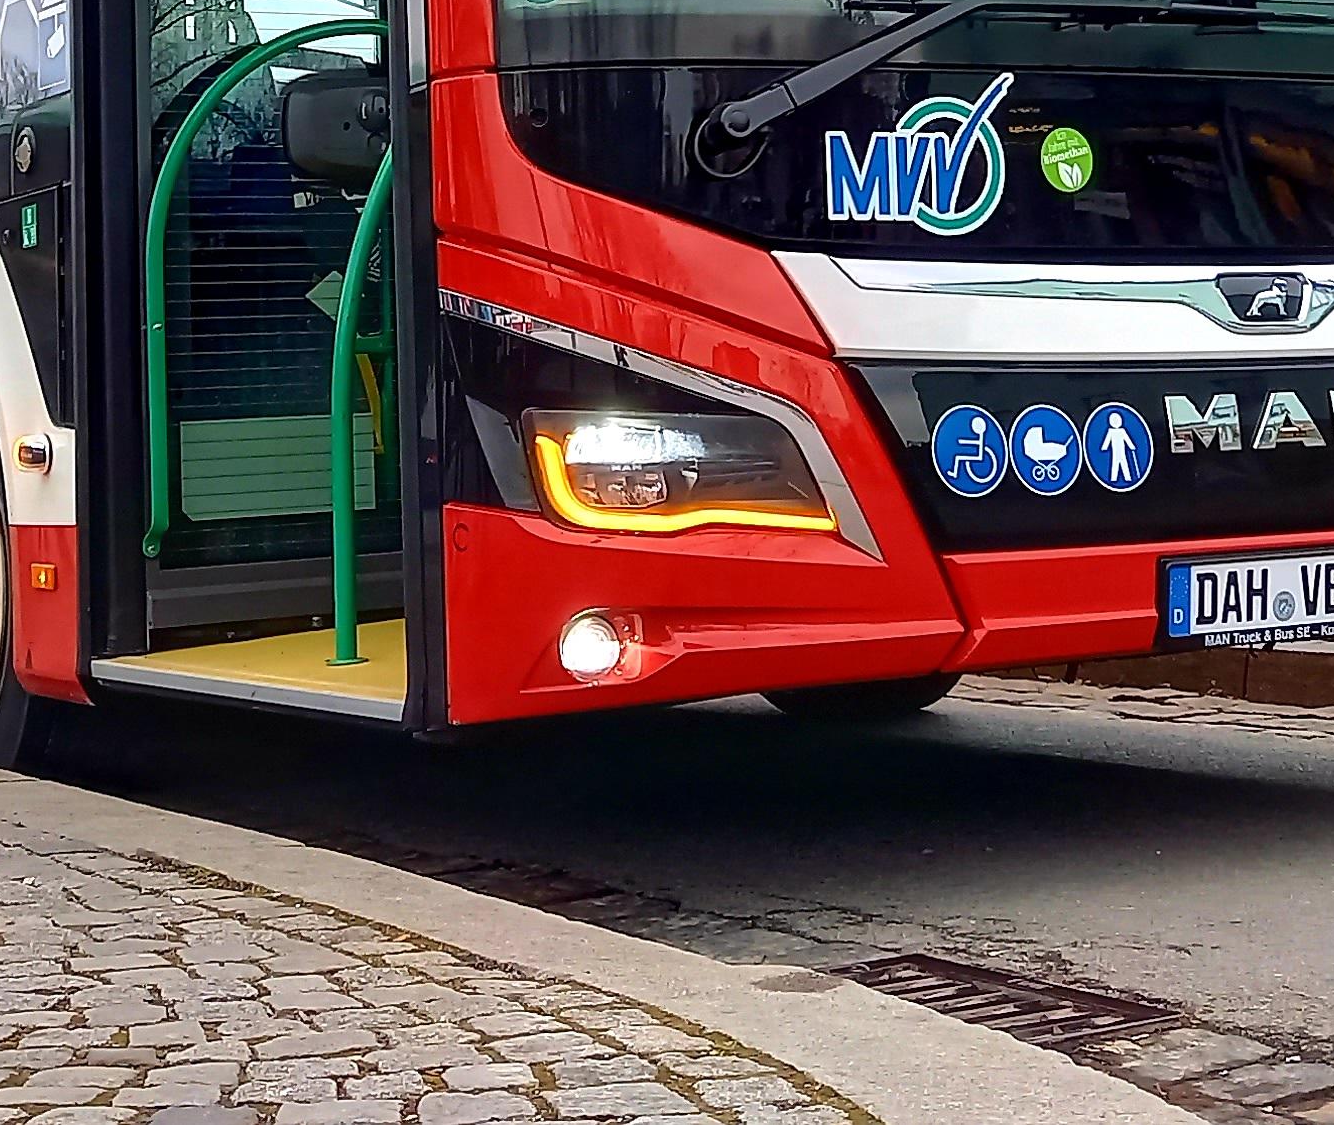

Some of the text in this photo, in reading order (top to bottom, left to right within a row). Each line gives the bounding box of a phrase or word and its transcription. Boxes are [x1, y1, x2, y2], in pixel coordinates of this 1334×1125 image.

[827, 74, 1012, 217] MVV
[1173, 608, 1184, 624] D
[1195, 568, 1269, 625] DAH
[1204, 632, 1231, 647] MAN
[1233, 631, 1262, 644] Truck
[1264, 629, 1272, 641] &
[1274, 628, 1295, 641] Bus
[1296, 626, 1311, 639] SE
